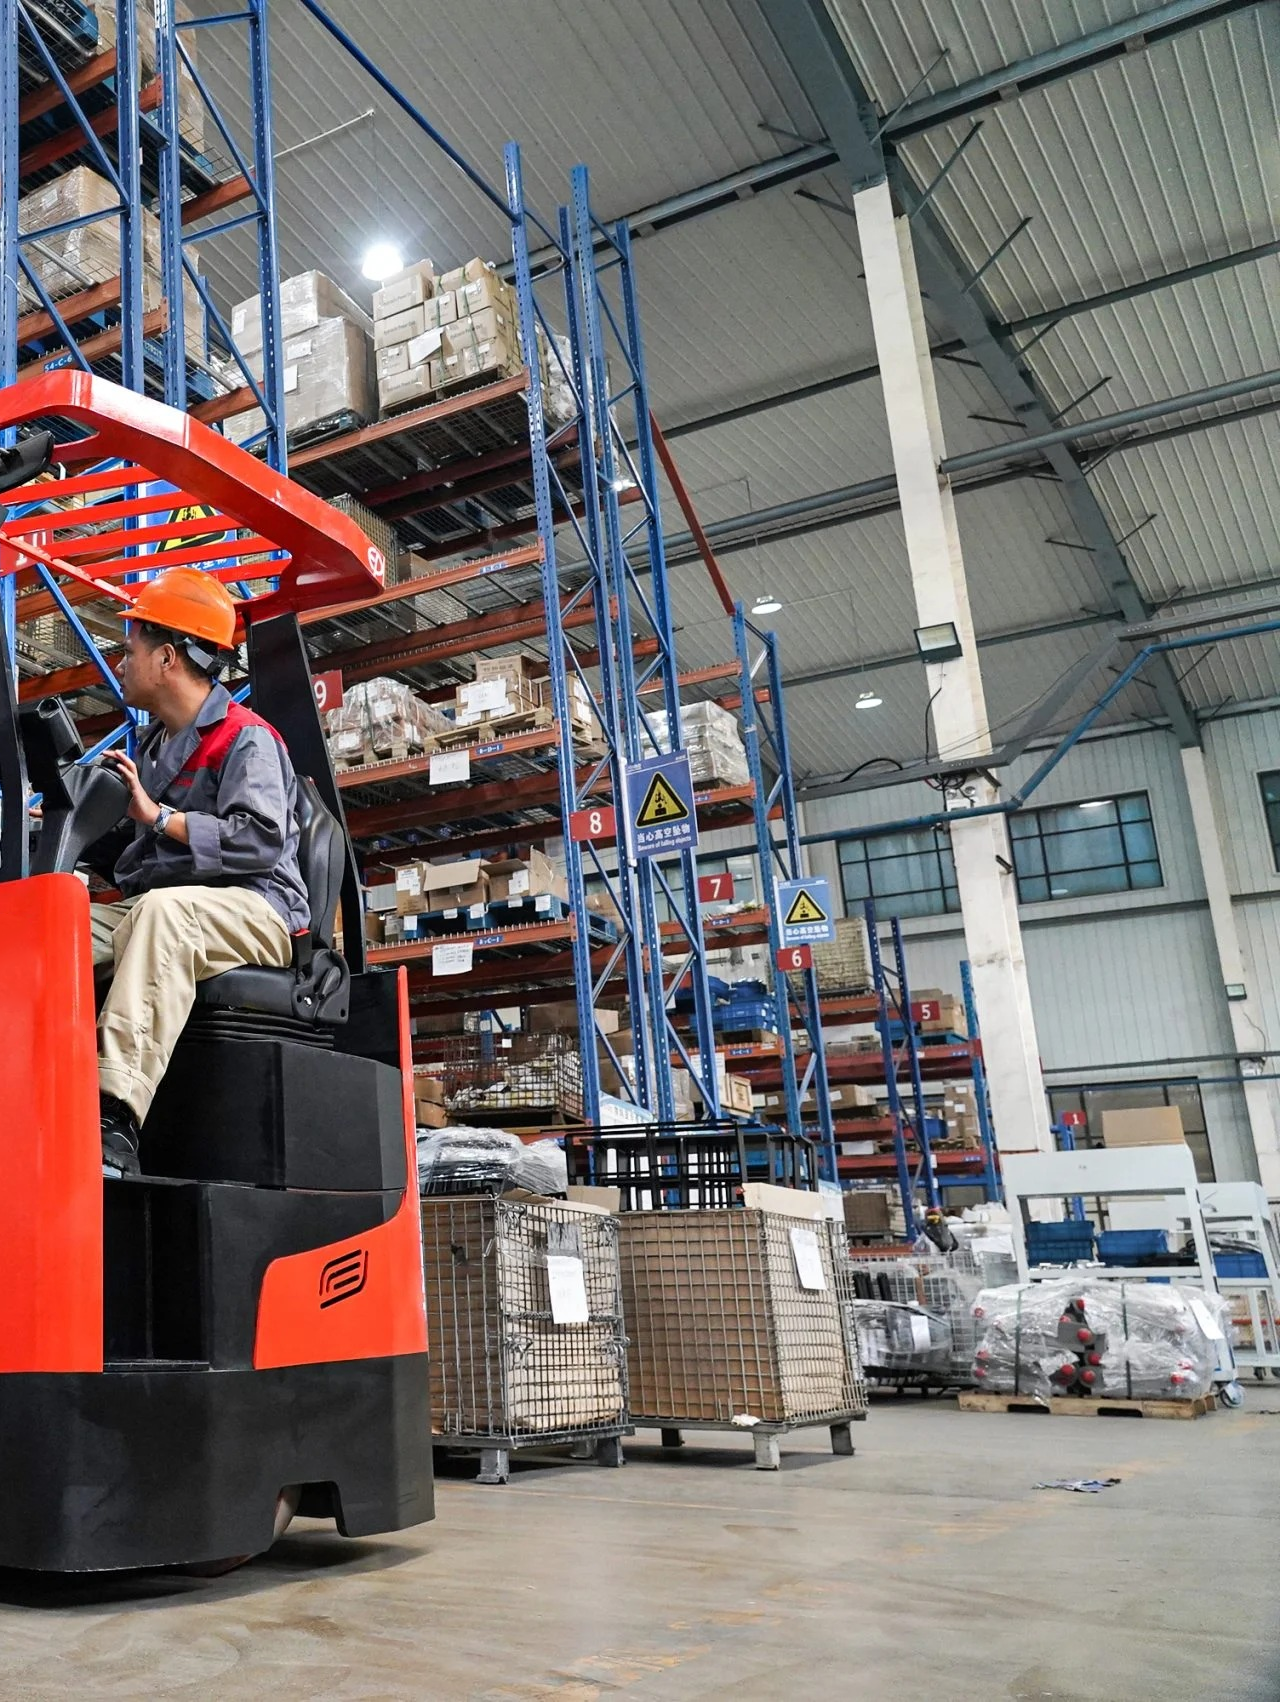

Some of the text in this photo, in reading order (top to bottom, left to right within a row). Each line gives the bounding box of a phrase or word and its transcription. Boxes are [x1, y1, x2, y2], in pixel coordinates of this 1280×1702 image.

[313, 679, 327, 709] 9
[588, 811, 603, 836] 8
[637, 823, 690, 842] 当心高空坠物
[709, 878, 722, 900] 7
[791, 949, 803, 968] 6
[921, 1003, 931, 1020] 5
[1072, 1112, 1080, 1125] 1
